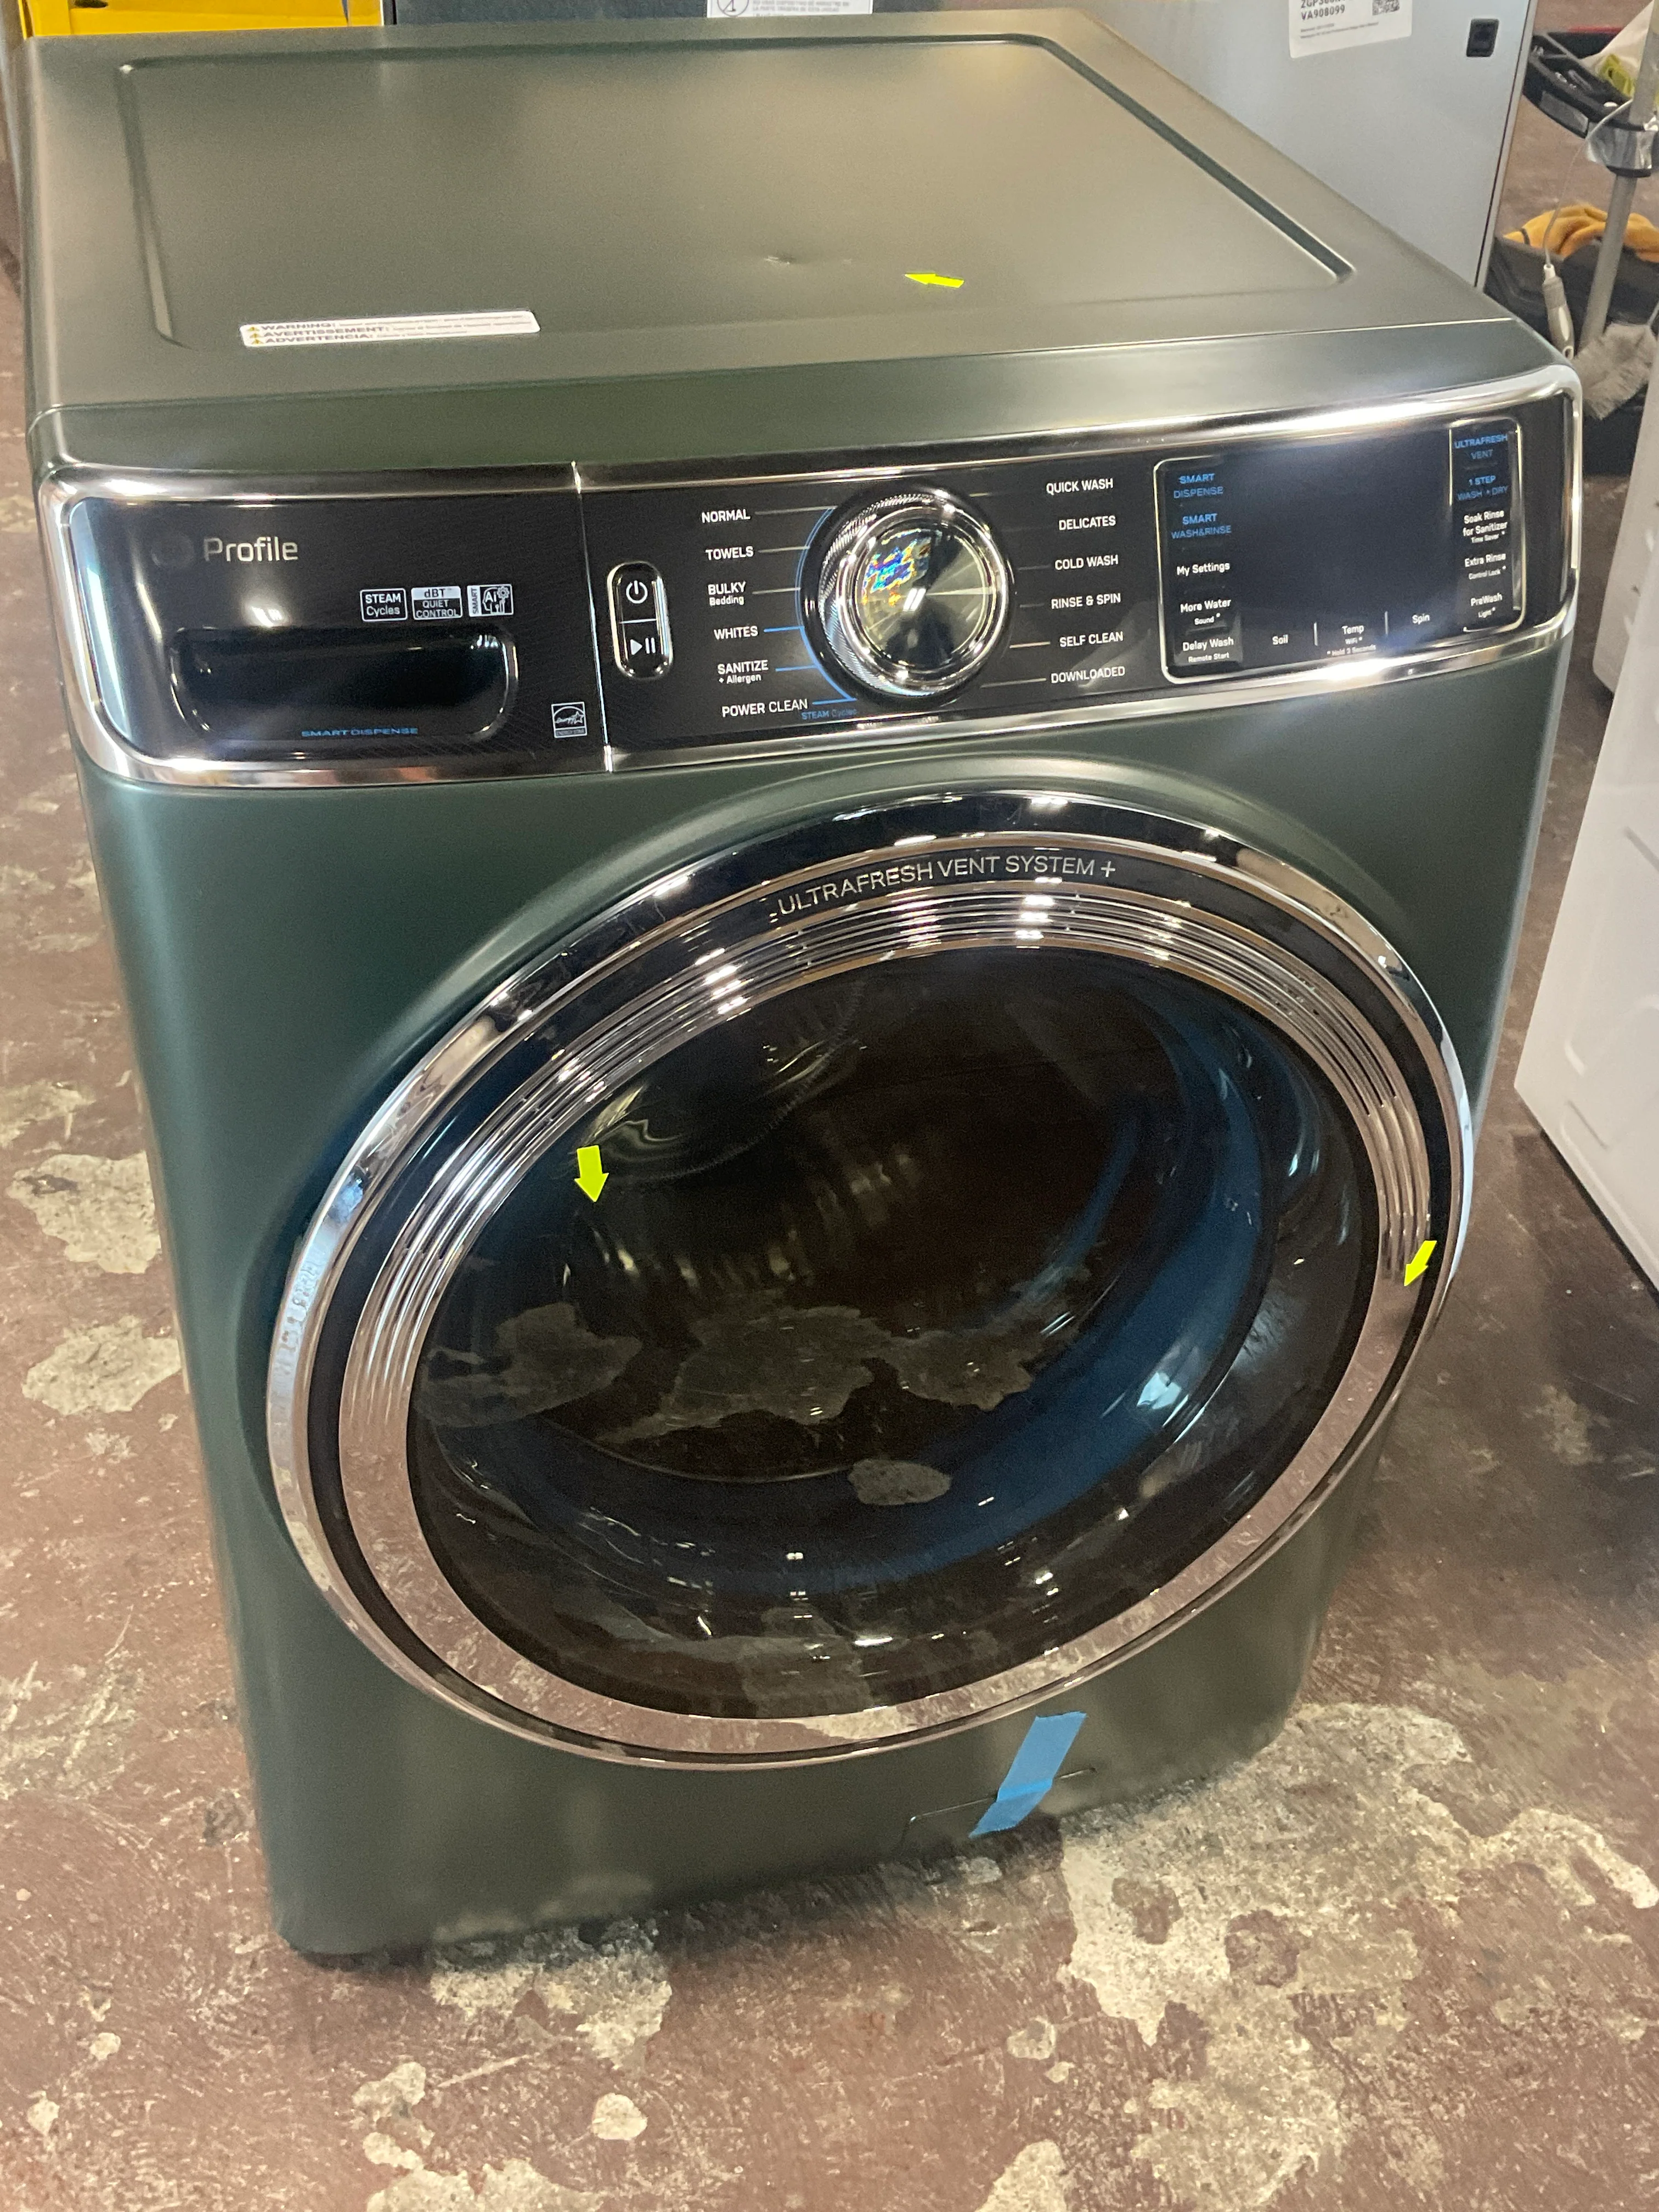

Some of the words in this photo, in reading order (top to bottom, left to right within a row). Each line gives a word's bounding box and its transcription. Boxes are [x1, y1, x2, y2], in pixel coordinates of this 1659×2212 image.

[1301, 4, 1345, 20] VA908099
[1454, 433, 1508, 449] ULTRAFRESH
[1470, 449, 1493, 459] VENT
[1179, 473, 1215, 484] SMART
[1475, 475, 1496, 485] STEP
[1046, 481, 1079, 495] QUICK
[1081, 478, 1113, 491] WASH
[1173, 486, 1224, 499] DISPENSE
[1458, 491, 1482, 501] WASH
[1492, 486, 1508, 495] DRY
[702, 509, 751, 523] NORMAL
[1059, 515, 1116, 531] DELICATES
[1182, 513, 1217, 525] SMART
[1464, 513, 1482, 524] Soak
[1483, 510, 1504, 521] Rinse
[1463, 527, 1474, 537] for
[1475, 522, 1508, 534] Sanitizer
[204, 536, 298, 562] Profile
[706, 546, 754, 561] TOWELS
[1055, 557, 1084, 571] COLD
[1087, 554, 1119, 567] WASH
[1464, 557, 1484, 568] Extra
[1486, 553, 1506, 563] Rinse
[1177, 565, 1190, 577] My
[1192, 562, 1230, 574] Settings
[708, 581, 746, 595] BULKY
[365, 593, 401, 604] STEAM
[422, 599, 449, 608] QUIET
[709, 595, 744, 607] Bedding
[1051, 596, 1083, 610] RINSE
[1086, 595, 1094, 606] &
[1097, 593, 1121, 605] SPIN
[1470, 592, 1502, 606] PreWash
[366, 606, 400, 617] Cycles
[1181, 602, 1202, 613] More
[1204, 599, 1231, 610] Water
[416, 609, 458, 618] CONTROL
[1412, 613, 1430, 624] Spin
[1194, 617, 1214, 625] Sound
[714, 626, 758, 640] WHITES
[1342, 625, 1364, 635] Temp
[1059, 635, 1086, 647] SELF
[1088, 631, 1124, 646] CLEAN
[1183, 640, 1207, 652] Delay
[1209, 637, 1234, 648] Wash
[1273, 634, 1288, 645] Soil
[1188, 654, 1212, 663] Remote
[1214, 651, 1229, 660] Start
[717, 659, 769, 675] SANITIZE
[726, 673, 761, 685] Allergen
[1051, 666, 1125, 684] DOWNLOADED
[722, 703, 765, 718] POWER
[769, 699, 808, 713] CLEAN
[802, 710, 830, 720] STEAM
[777, 862, 933, 916] ULTRAFRESH
[937, 856, 1000, 878] VENT
[1005, 855, 1095, 875] SYSTEM
